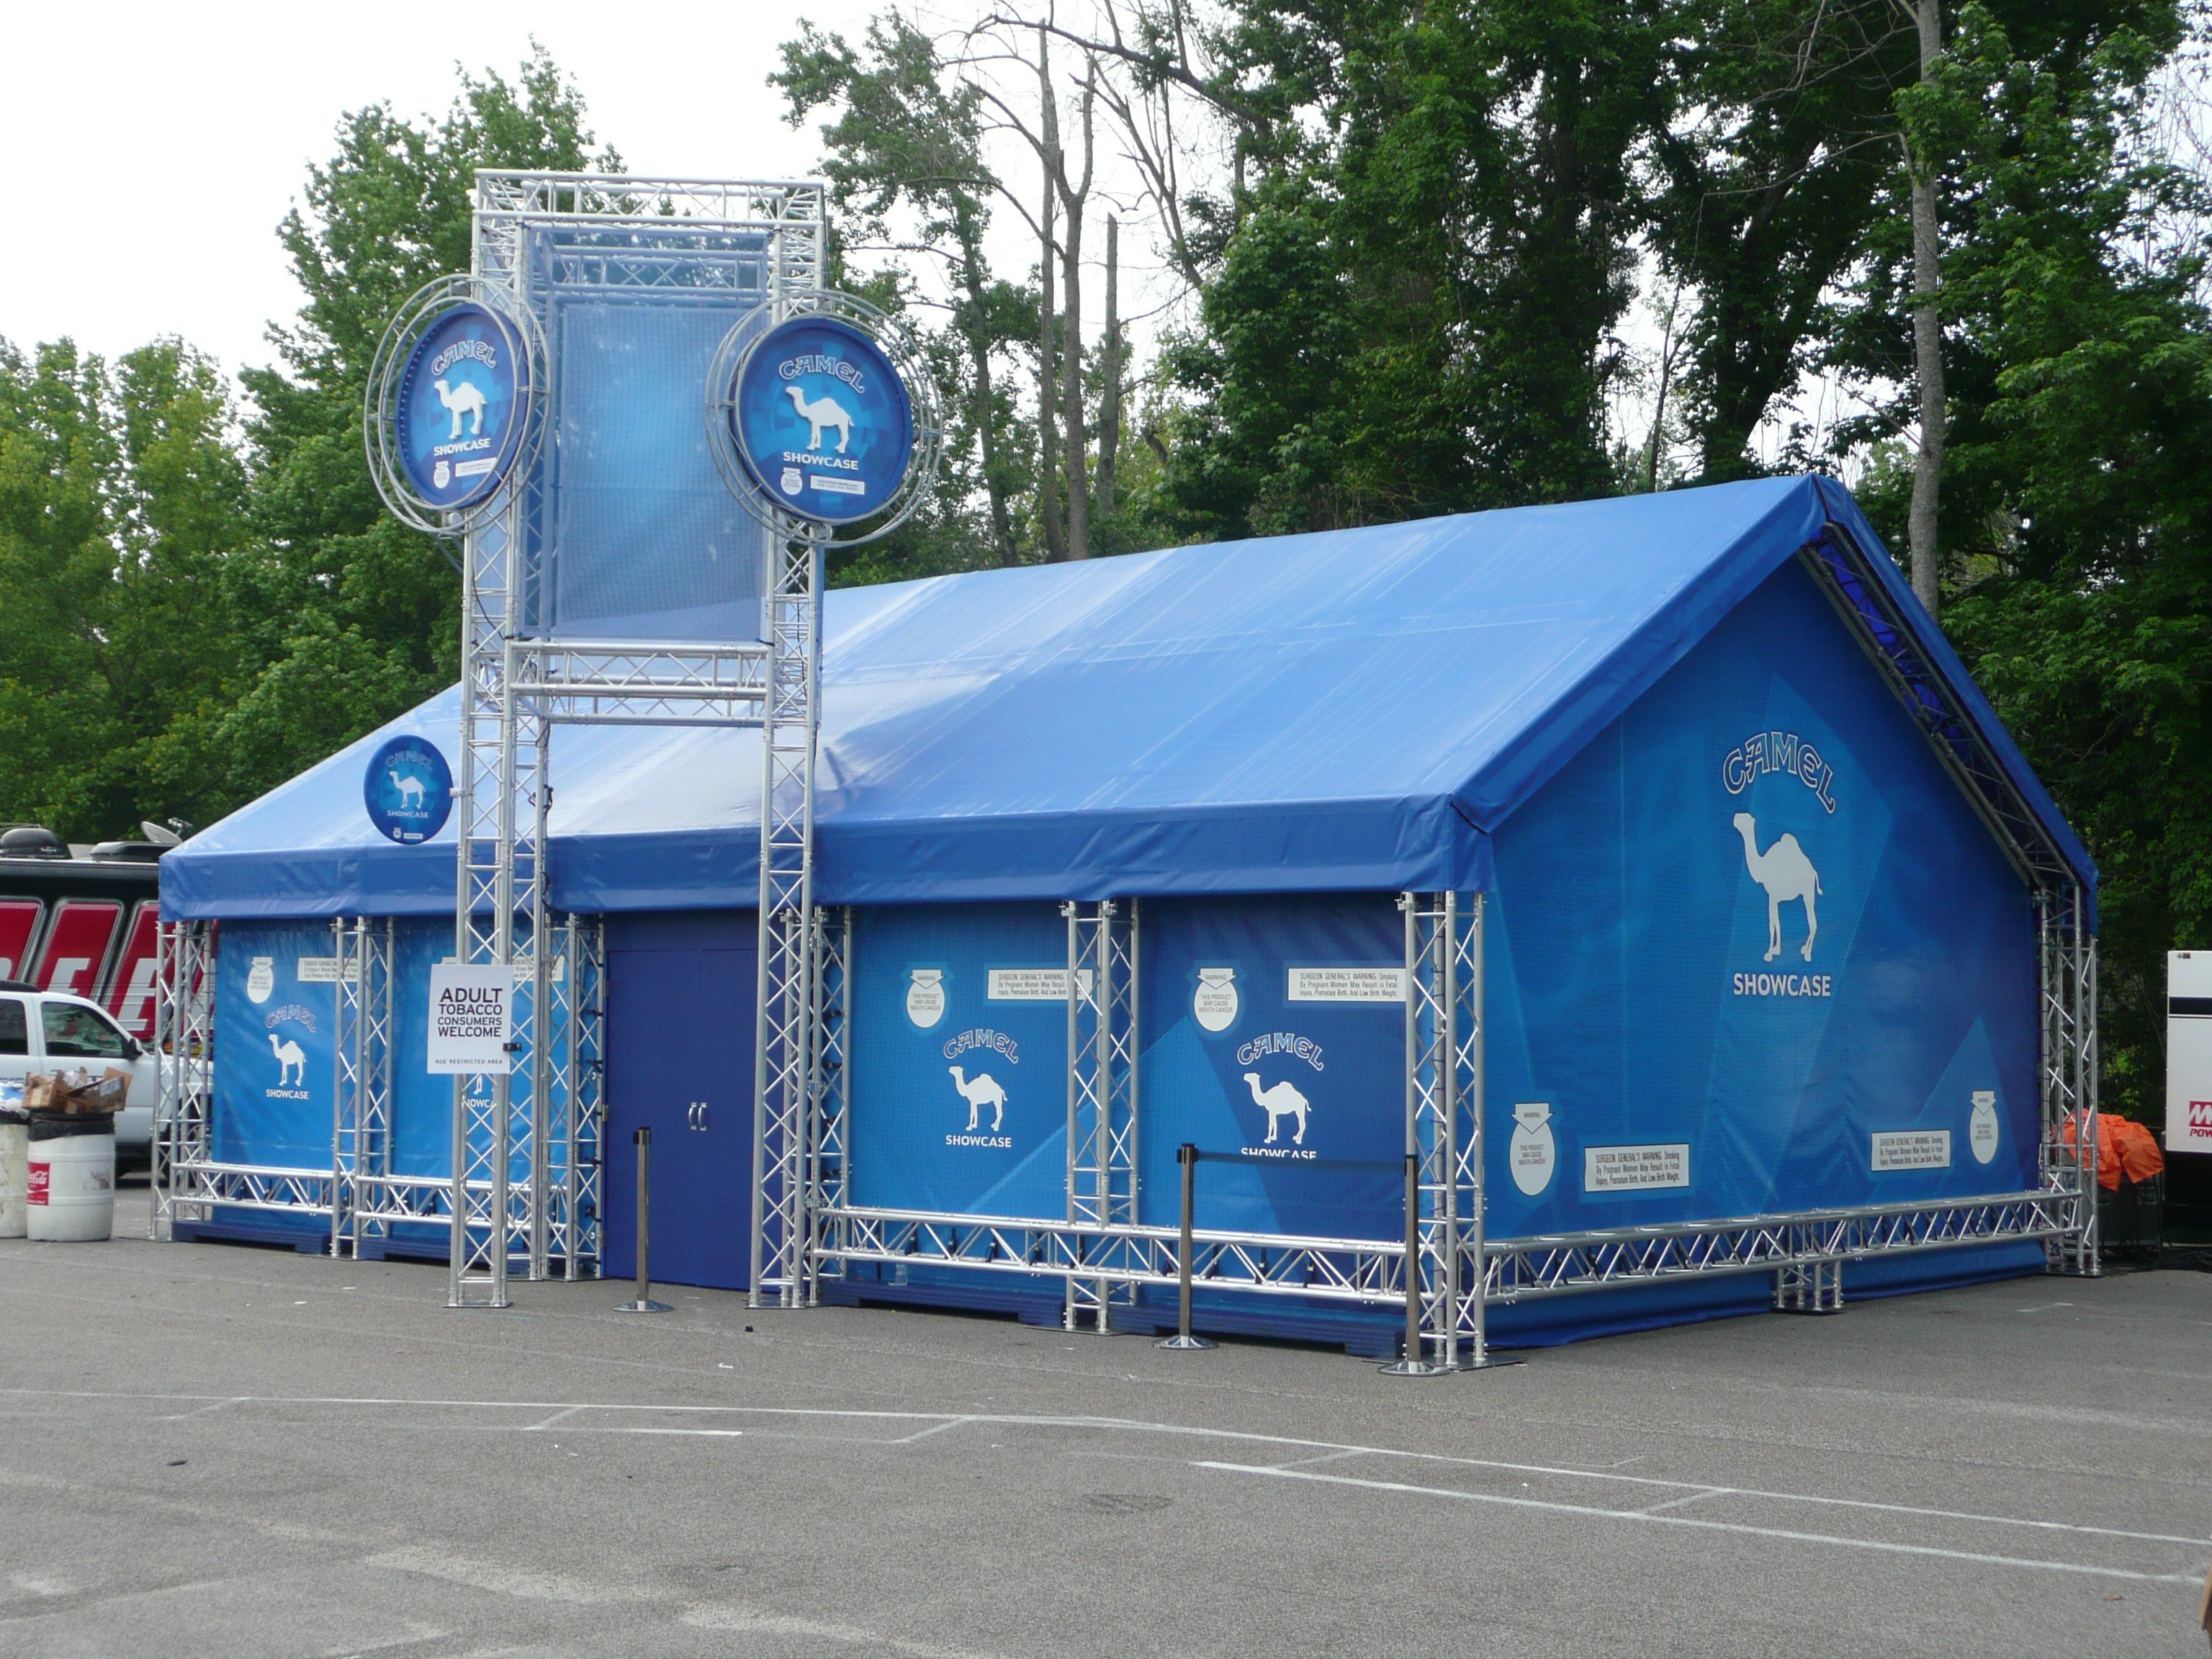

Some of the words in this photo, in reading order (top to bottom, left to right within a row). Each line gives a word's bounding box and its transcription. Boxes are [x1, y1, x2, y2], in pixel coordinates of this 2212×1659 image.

[431, 340, 496, 376] CAMEL
[778, 354, 865, 394] CAMEL
[433, 438, 491, 457] SHOWCASE
[783, 451, 858, 470] SHOWCASE
[385, 750, 433, 772] CAMEL
[1723, 731, 1835, 814] CAMEL
[387, 809, 429, 819] SHOWCASE
[1733, 973, 1831, 997] SHOWCASE
[439, 988, 503, 1003] ADULT
[265, 1004, 316, 1033] CAMEL
[438, 1004, 503, 1015] TOBACCO
[437, 1017, 502, 1026] CONSUMERS
[438, 1026, 501, 1038] WELCOME
[943, 1028, 1019, 1064] CAMEL
[1237, 1033, 1324, 1071] CAMEL
[266, 1089, 310, 1100] SHOWCASE
[945, 1135, 1012, 1148] SHOWCASE
[1241, 1147, 1317, 1160] SHOWCASE
